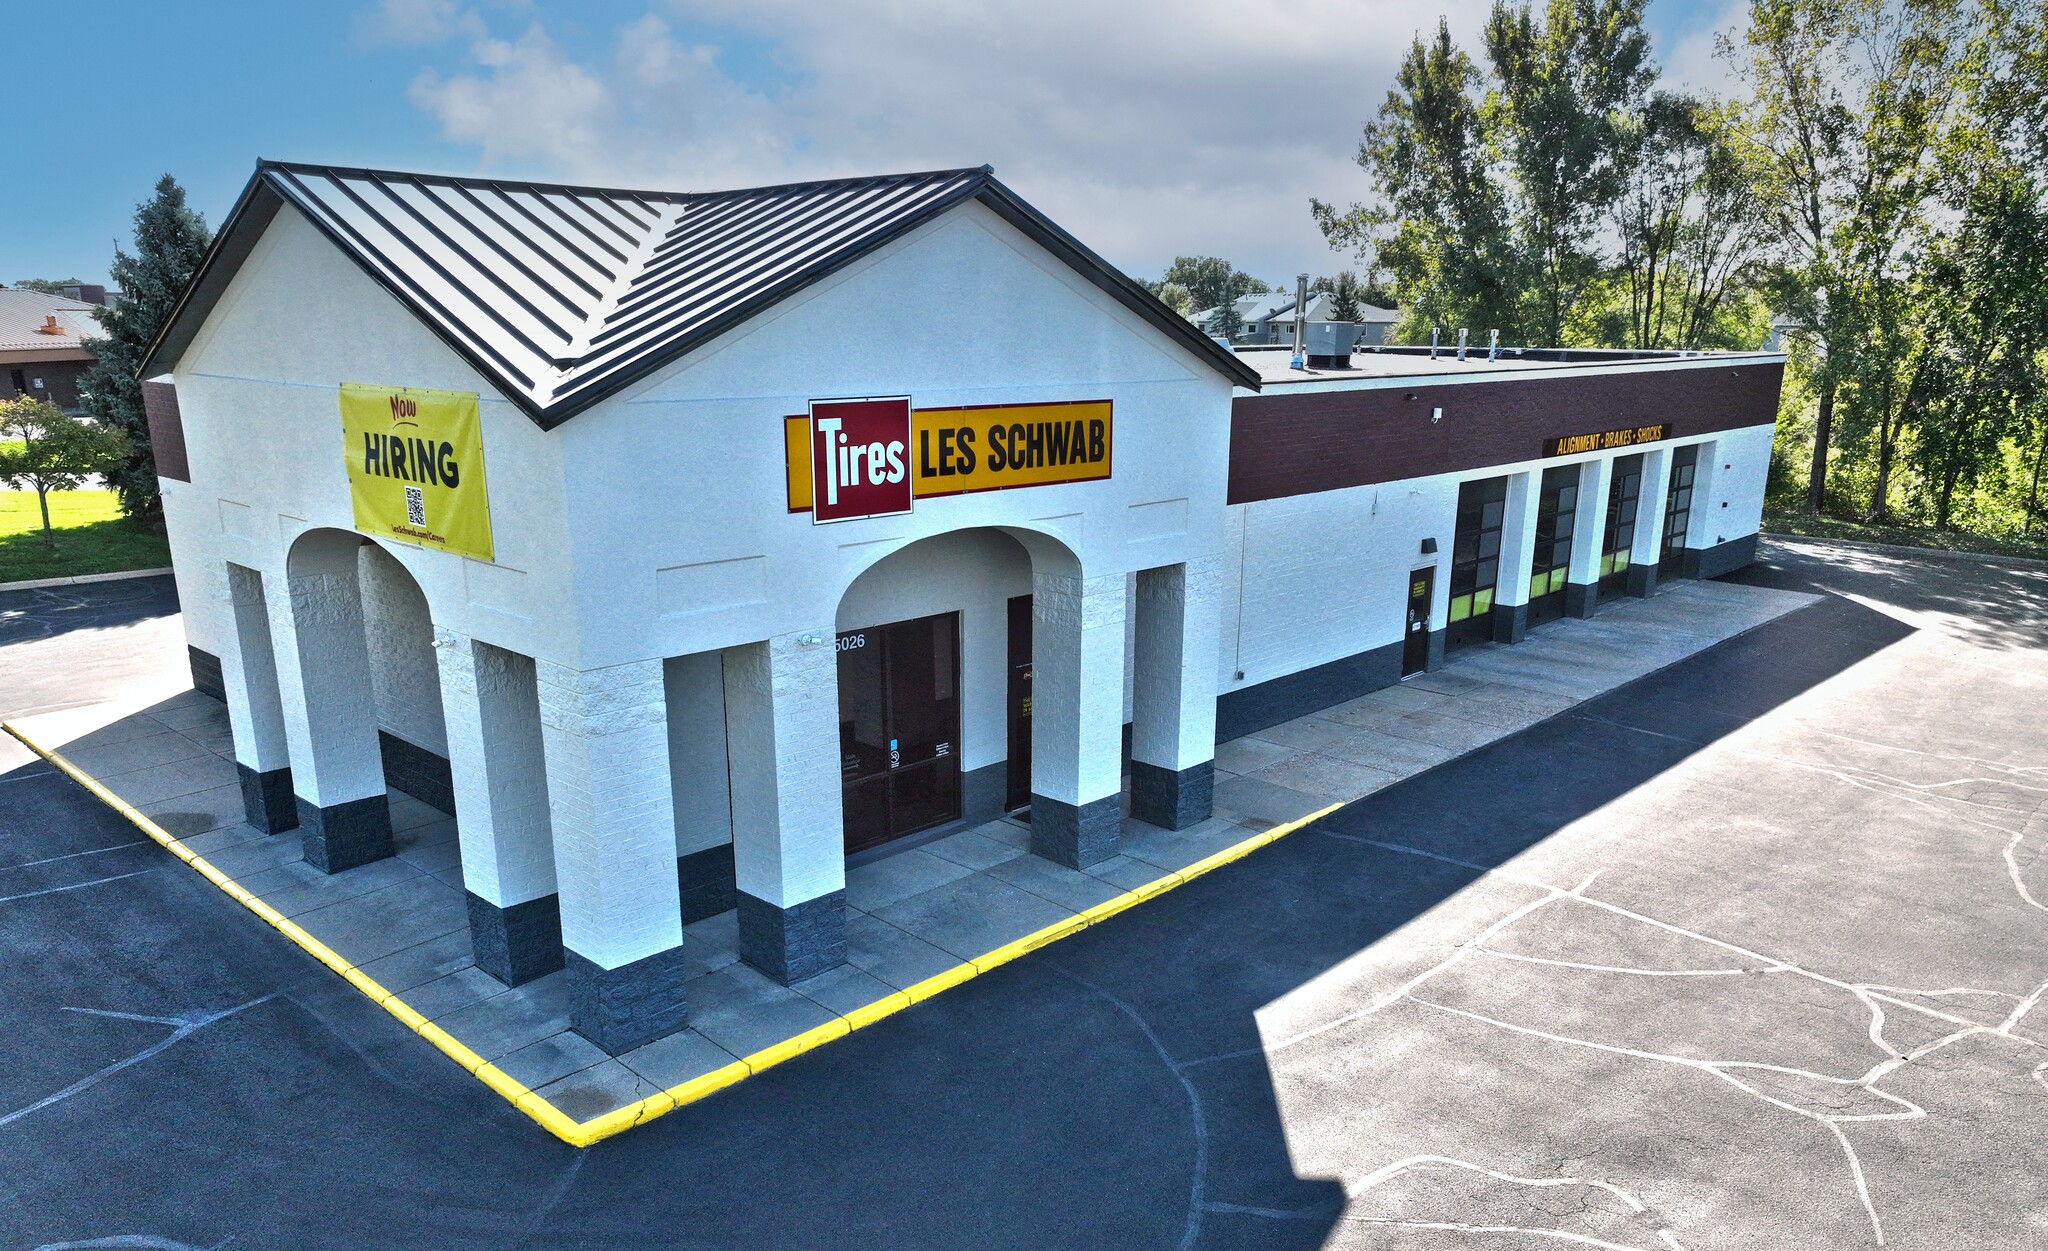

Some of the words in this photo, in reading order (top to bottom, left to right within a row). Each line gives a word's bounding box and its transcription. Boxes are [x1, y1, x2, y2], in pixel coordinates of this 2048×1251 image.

[364, 432, 460, 488] HIRING
[818, 418, 904, 505] Tires
[920, 427, 976, 478] LES
[988, 419, 1105, 472] SCHWAB
[1557, 434, 1601, 455] ALIGNMENT
[1604, 429, 1632, 448] BRAKES
[1637, 425, 1663, 443] SHOCKS
[836, 634, 865, 652] 5026
